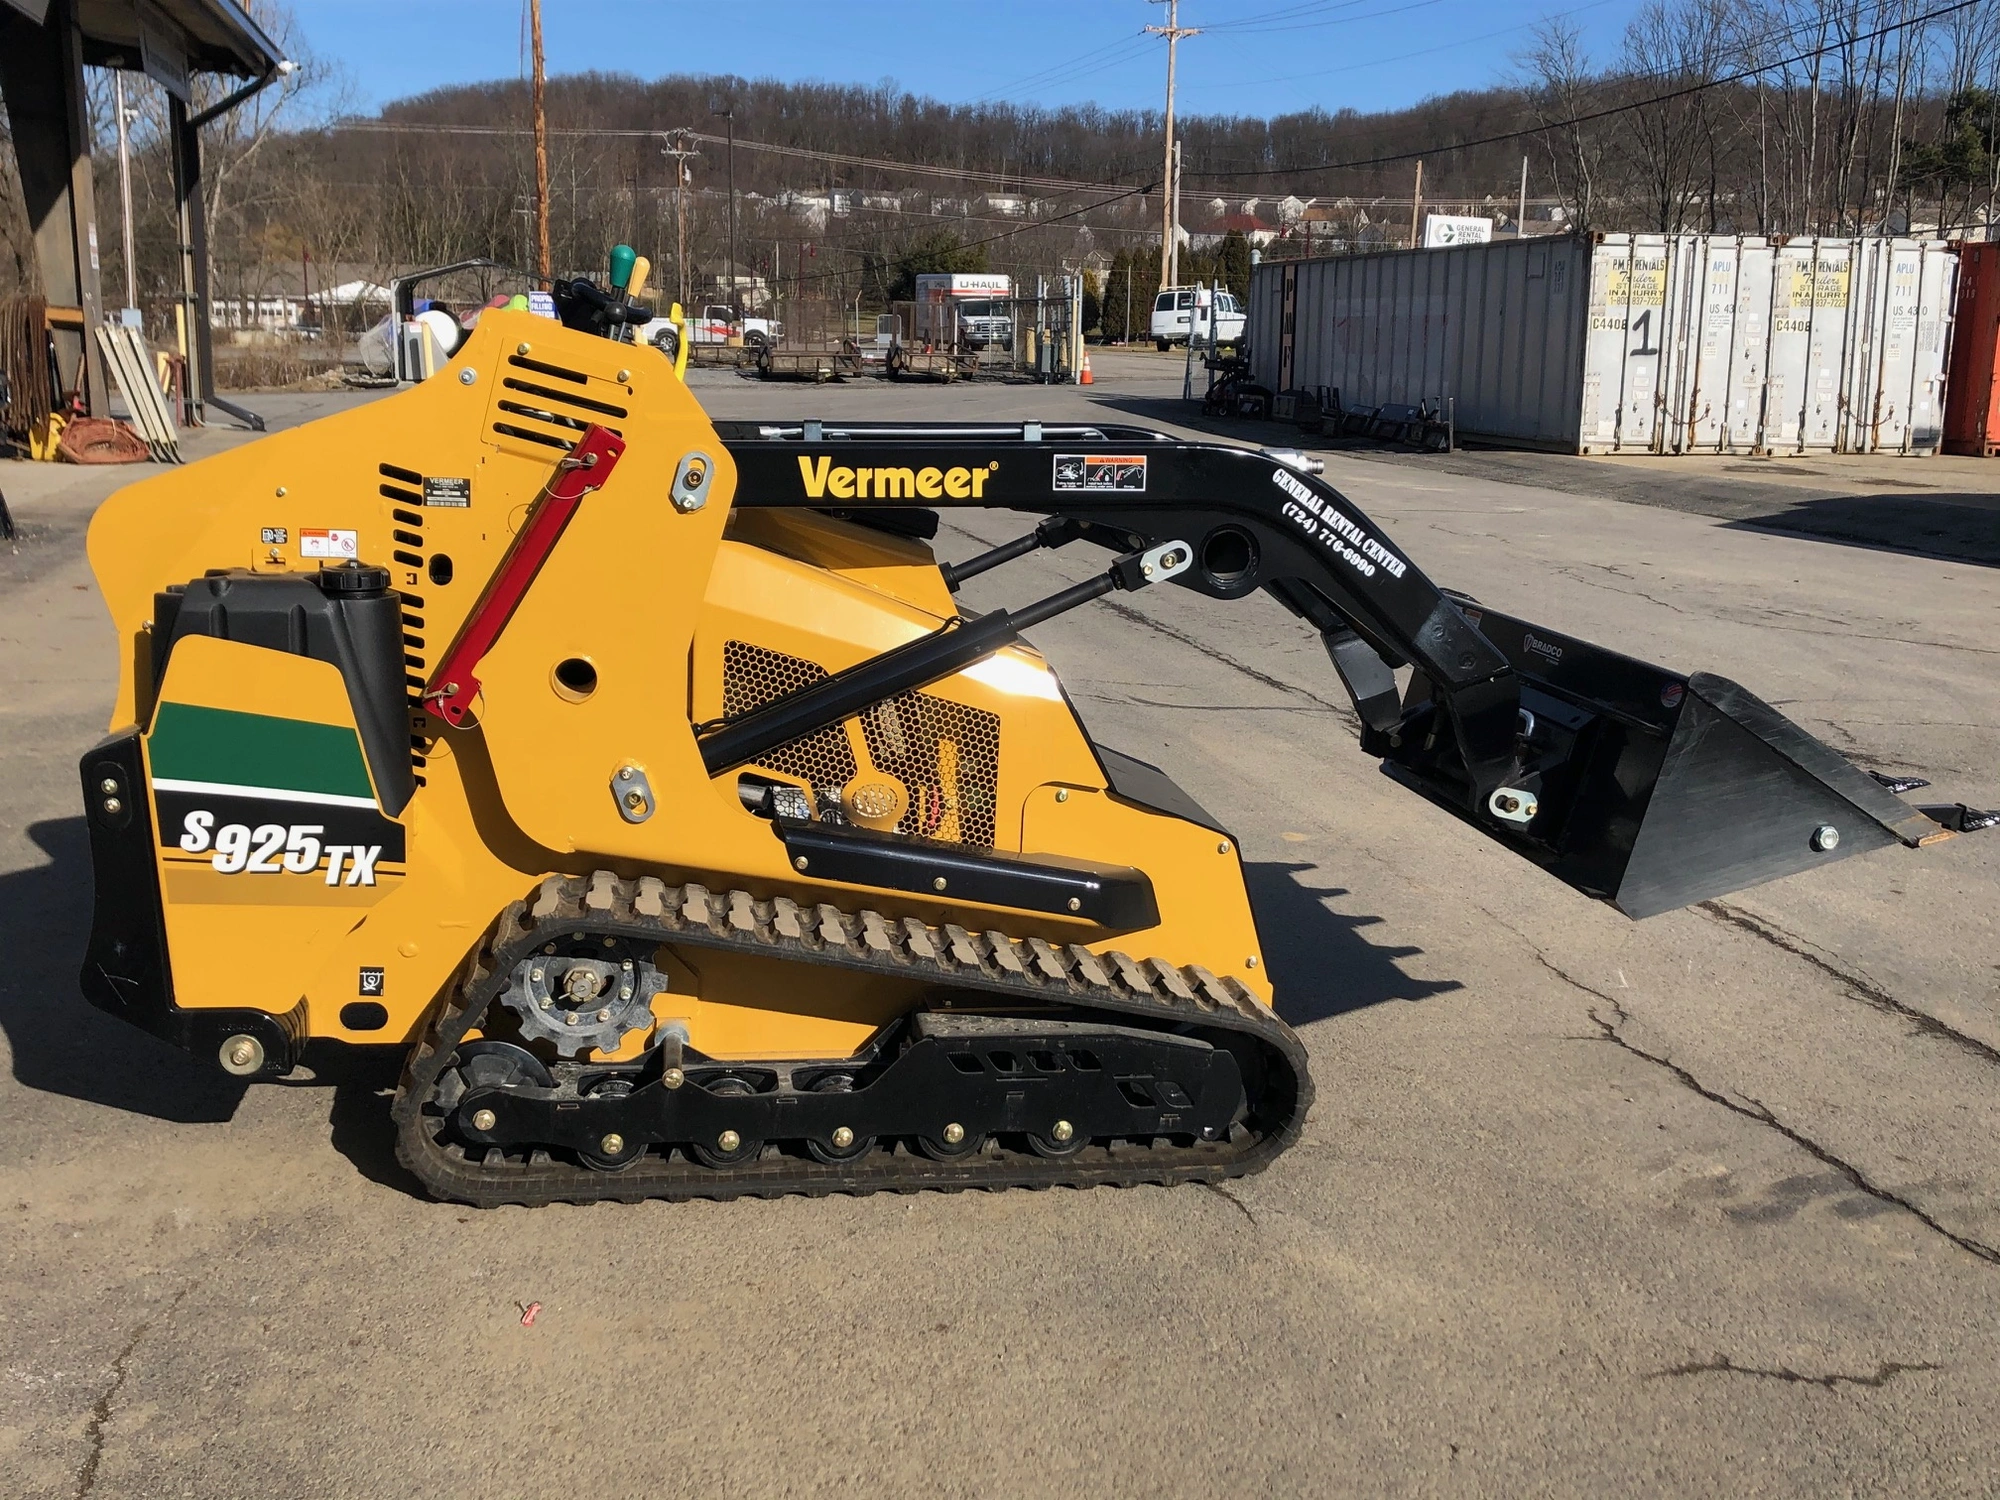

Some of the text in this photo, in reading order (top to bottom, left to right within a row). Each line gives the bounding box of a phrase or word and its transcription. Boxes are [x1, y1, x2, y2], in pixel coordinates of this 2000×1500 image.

[1457, 224, 1485, 232] GENERAL
[1458, 231, 1482, 239] RENTAL
[1635, 259, 1665, 271] RENTALS
[1712, 261, 1731, 272] APLU
[1818, 261, 1848, 273] RENTALS
[1896, 263, 1915, 274] APLU
[960, 281, 1001, 289] U-HAUL
[1711, 284, 1728, 295] 711
[1895, 286, 1912, 297] 711
[531, 302, 553, 311] FILLING
[1709, 304, 1720, 314] US
[1893, 306, 1904, 316] US
[1629, 308, 1658, 357] 1
[797, 455, 990, 499] Vermeer
[1272, 468, 1407, 579] GENERAL RENTAL CENTER
[1281, 502, 1376, 577] (724) 776-6990
[1531, 638, 1563, 659] BRADCO
